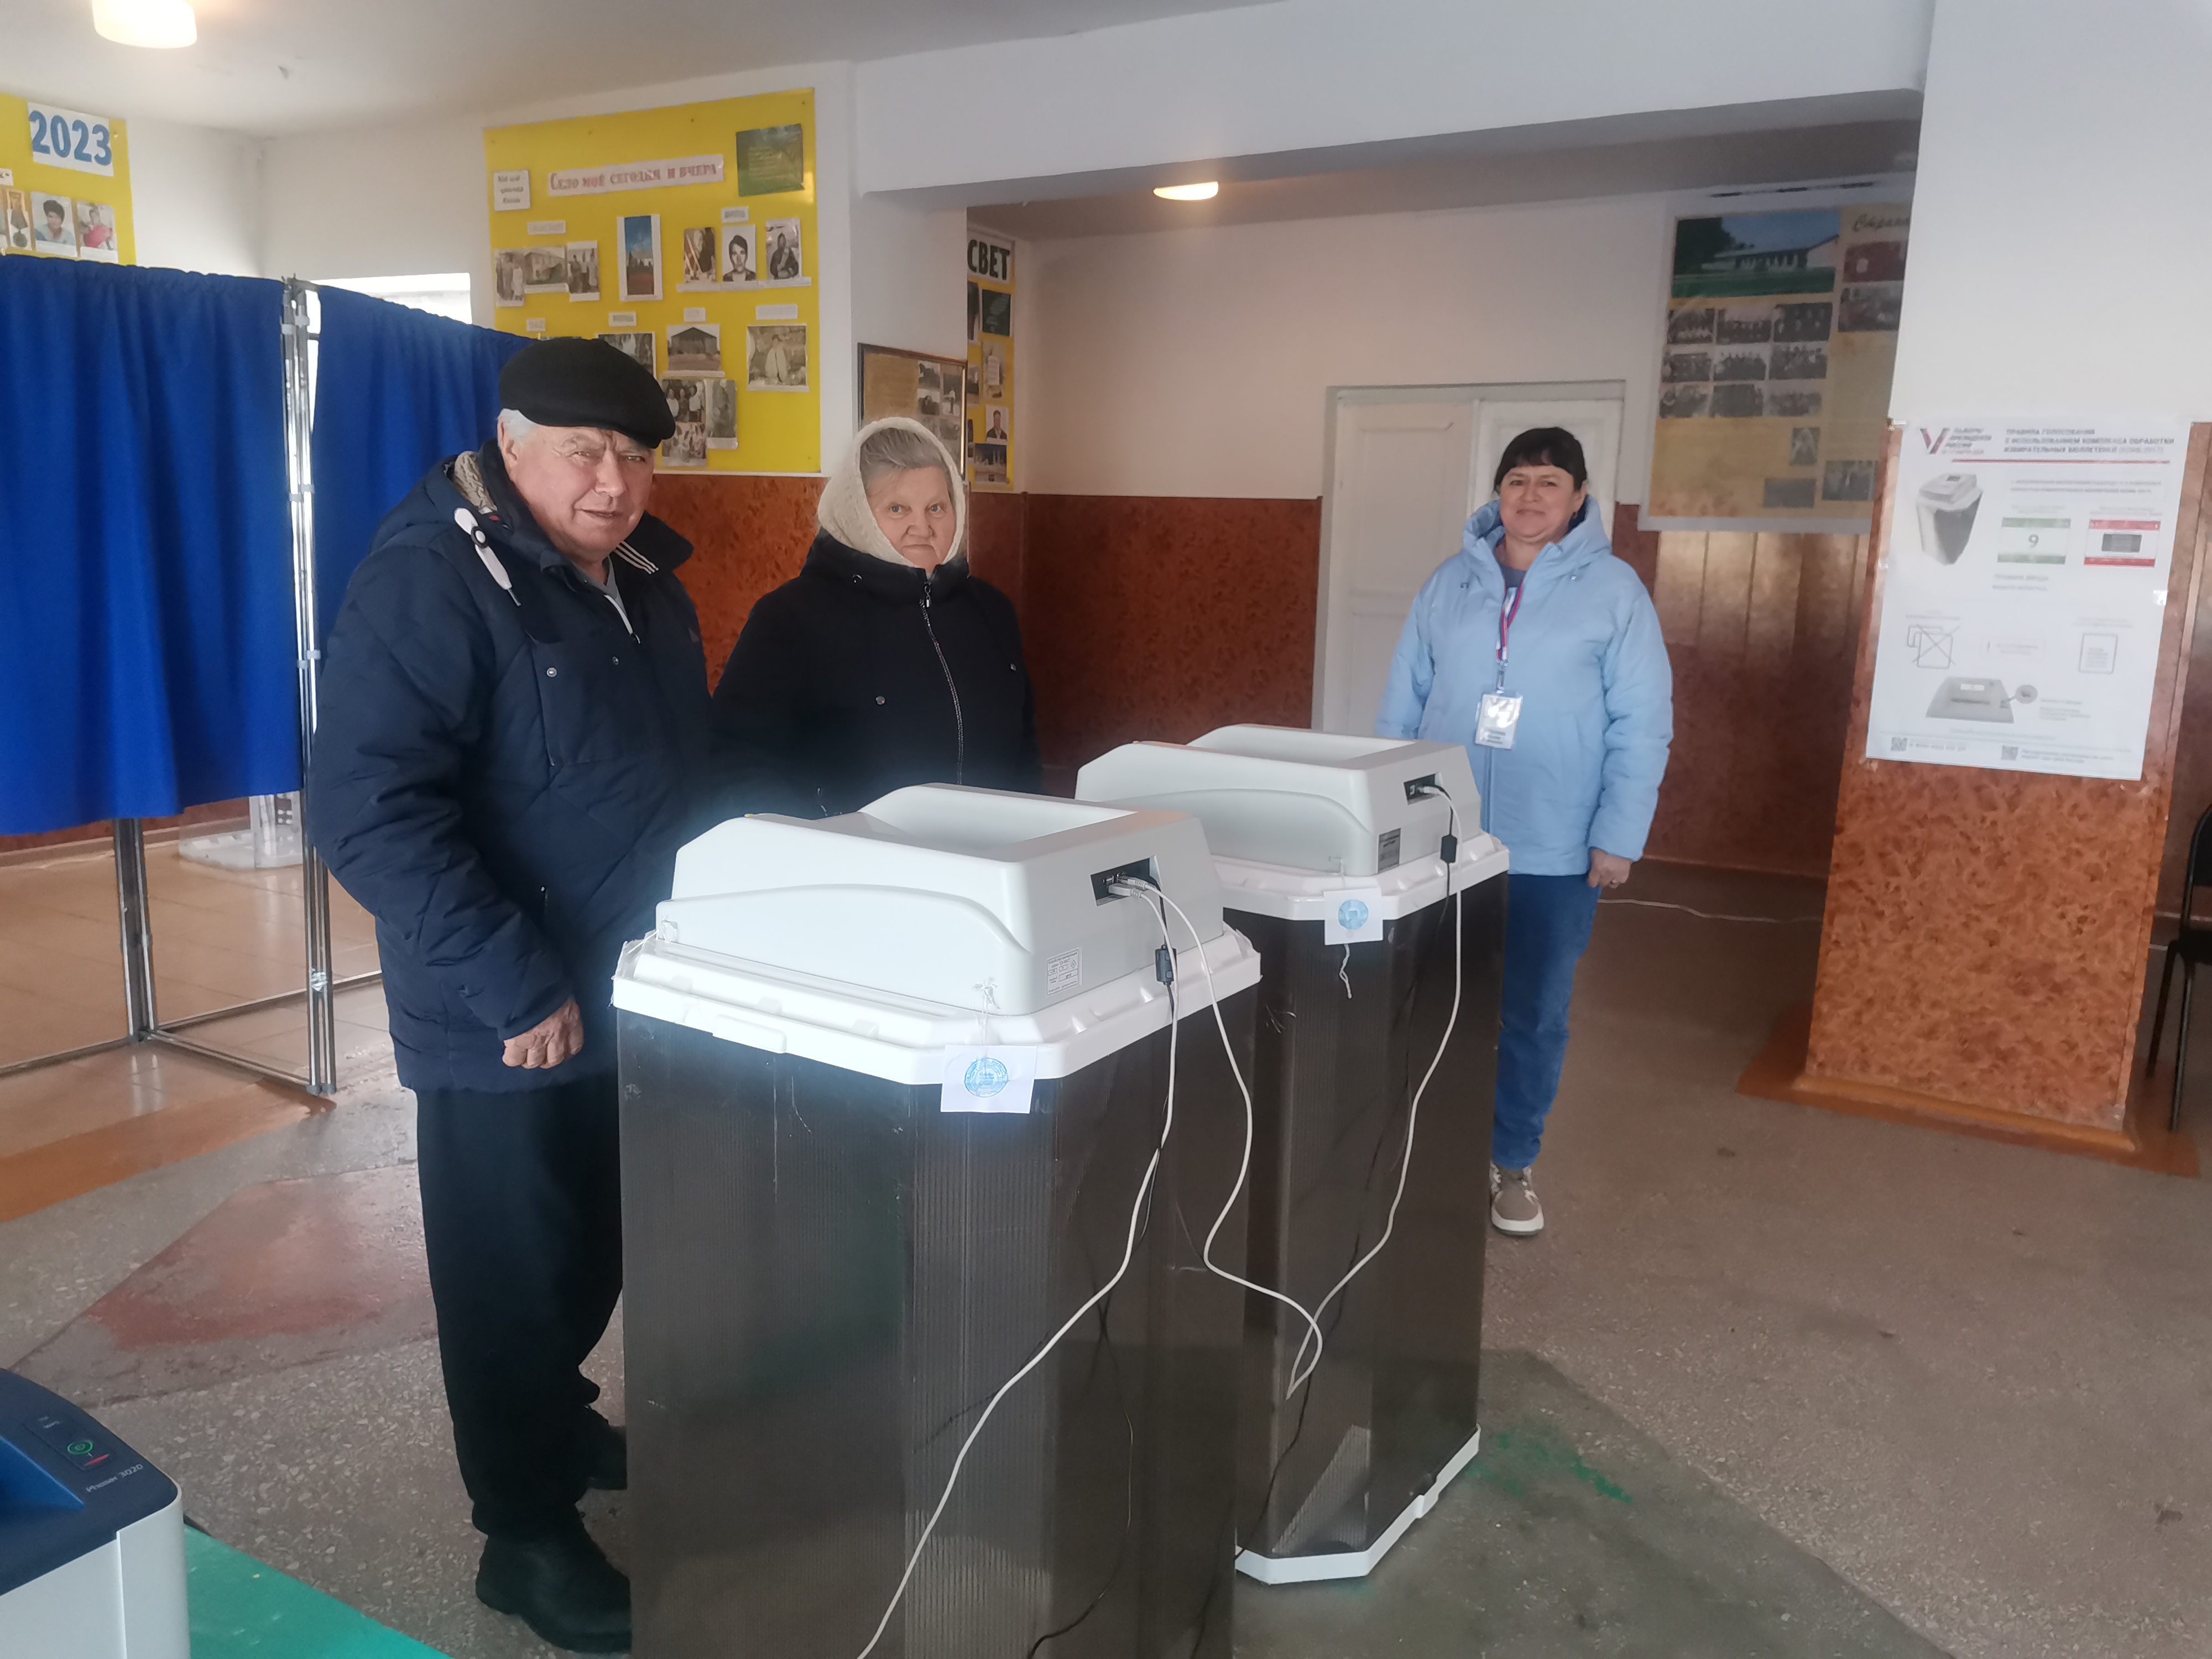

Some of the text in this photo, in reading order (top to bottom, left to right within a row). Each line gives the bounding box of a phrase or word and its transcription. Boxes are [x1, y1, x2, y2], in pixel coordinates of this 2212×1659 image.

[29, 110, 112, 166] 2023
[967, 239, 1010, 280] СВЕТ
[2028, 533, 2039, 548] 9
[117, 1464, 144, 1478] 3020
